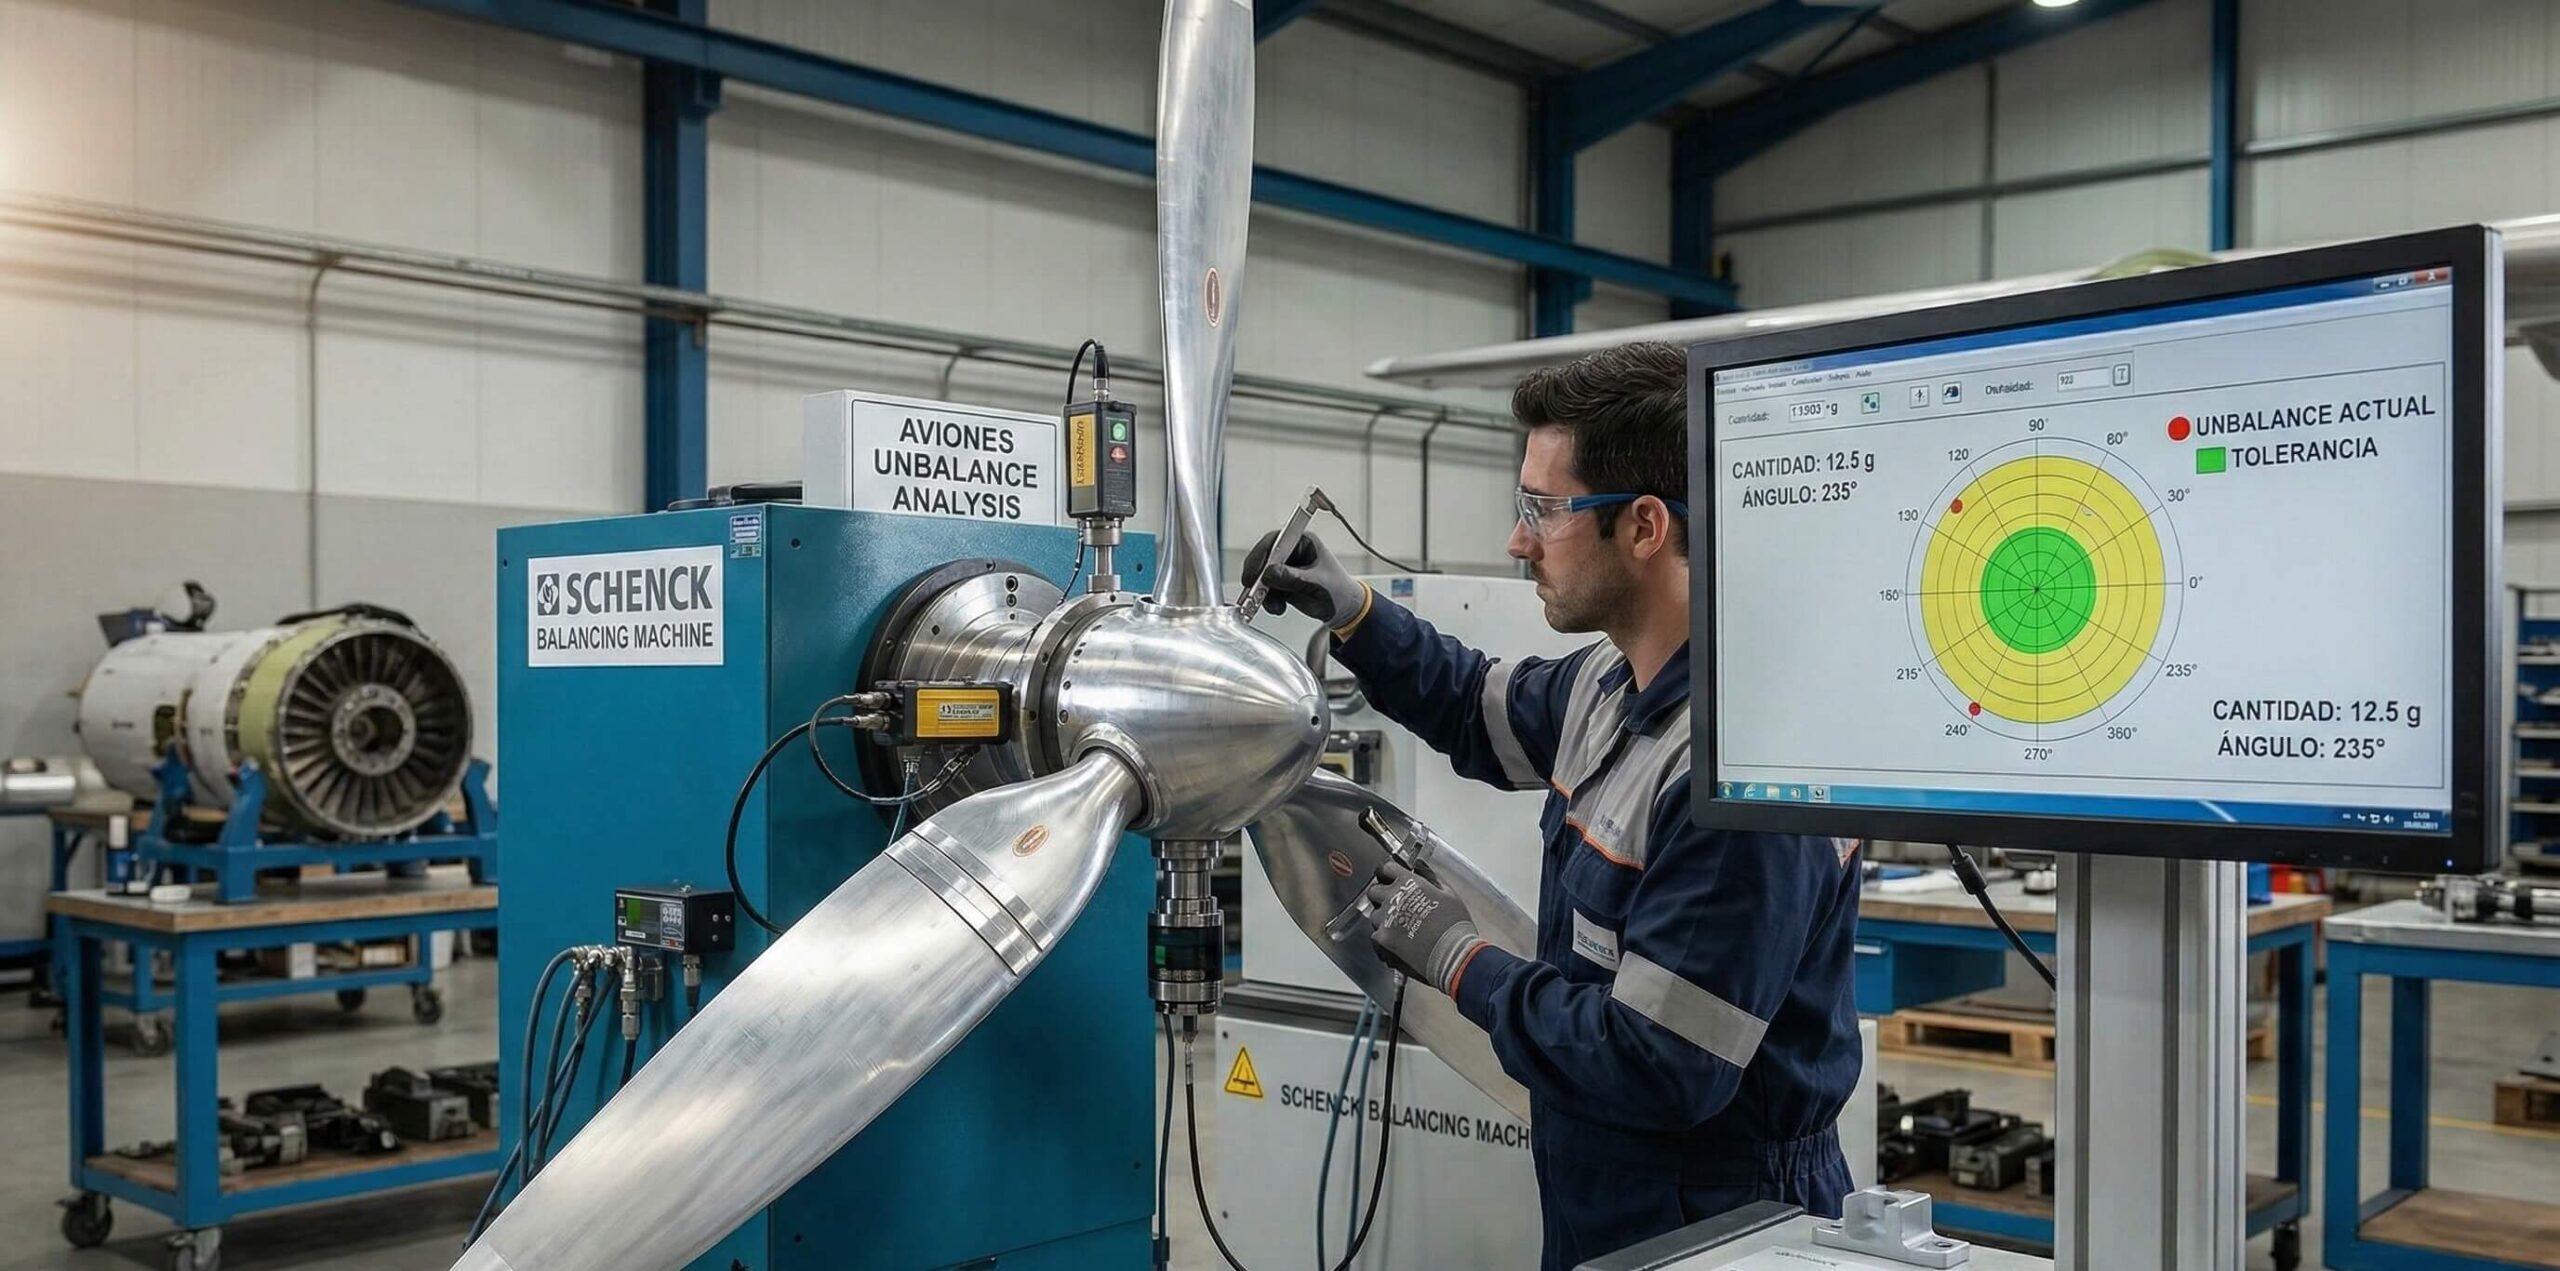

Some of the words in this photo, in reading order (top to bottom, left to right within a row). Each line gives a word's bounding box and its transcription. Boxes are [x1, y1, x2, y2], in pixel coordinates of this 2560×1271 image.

[2196, 404, 2332, 436] UNBALANCE
[2339, 395, 2436, 423] ACTUAL
[899, 417, 1014, 454] AVIONES
[1732, 455, 1821, 480] CANTIDAD:
[1826, 450, 1860, 471] 12.5
[1864, 453, 1875, 472] g
[2231, 436, 2379, 468] TOLERANCIA
[874, 448, 1038, 489] UNBALANCE
[892, 485, 1021, 520] ANALYSIS
[1742, 486, 1817, 509] ÁNGULO:
[1821, 480, 1858, 502] 235°
[2167, 488, 2191, 502] 30°
[566, 564, 713, 616] SCHENCK
[2189, 575, 2204, 588] 0°
[537, 624, 629, 650] BALANCING
[634, 622, 714, 649] MACHINE
[2166, 664, 2198, 678] 235°
[2213, 699, 2342, 722] CANTIDAD:
[2351, 700, 2399, 723] 12.5
[2407, 705, 2421, 728] g
[2107, 726, 2138, 740] 360°
[2217, 729, 2326, 758] ÁNGULO:
[2333, 738, 2386, 759] 235°
[2024, 748, 2054, 761] 270°
[1281, 1084, 1361, 1118] SCHENCK
